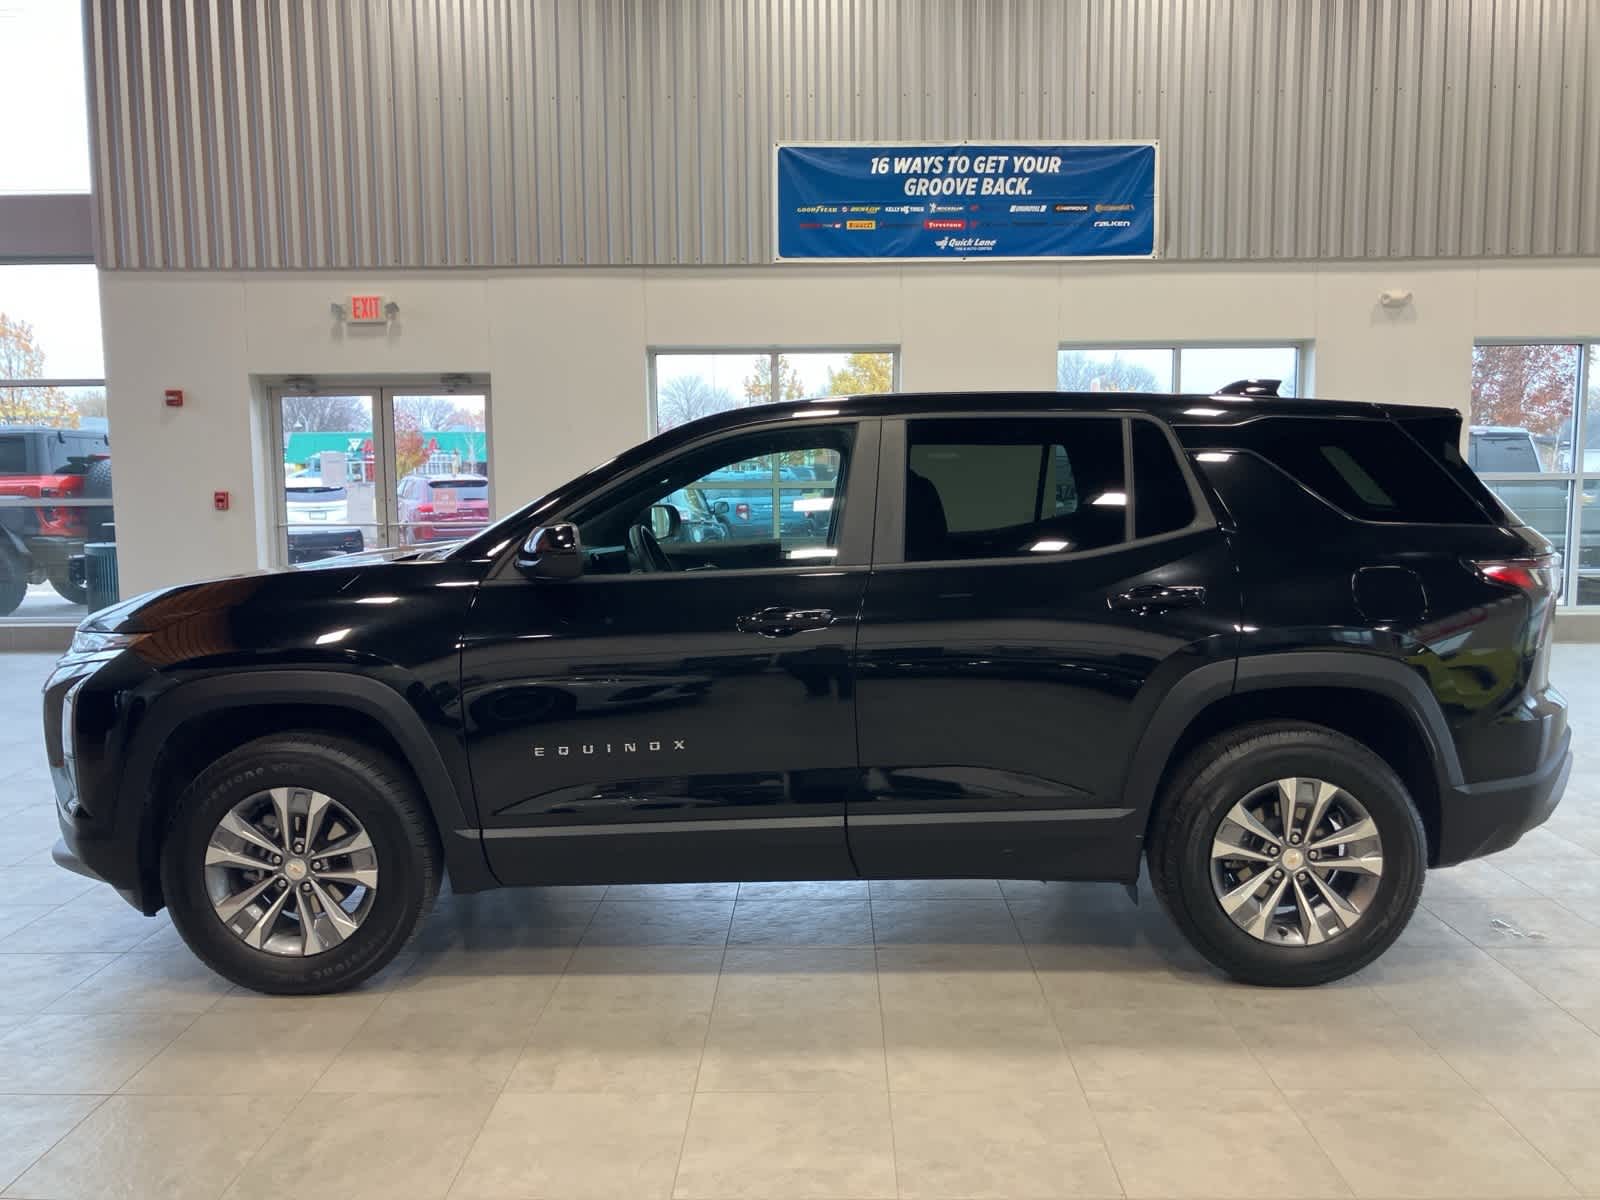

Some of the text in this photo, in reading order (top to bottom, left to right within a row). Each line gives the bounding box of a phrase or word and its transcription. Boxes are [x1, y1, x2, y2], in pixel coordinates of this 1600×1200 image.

[871, 155, 1062, 175] 16 WAYS TO GET YOUR
[904, 177, 1033, 196] GROOVE BACK.
[948, 238, 974, 248] Quick
[974, 238, 996, 246] Lane
[352, 296, 381, 320] EXIT
[534, 739, 685, 757] EQUINOX
